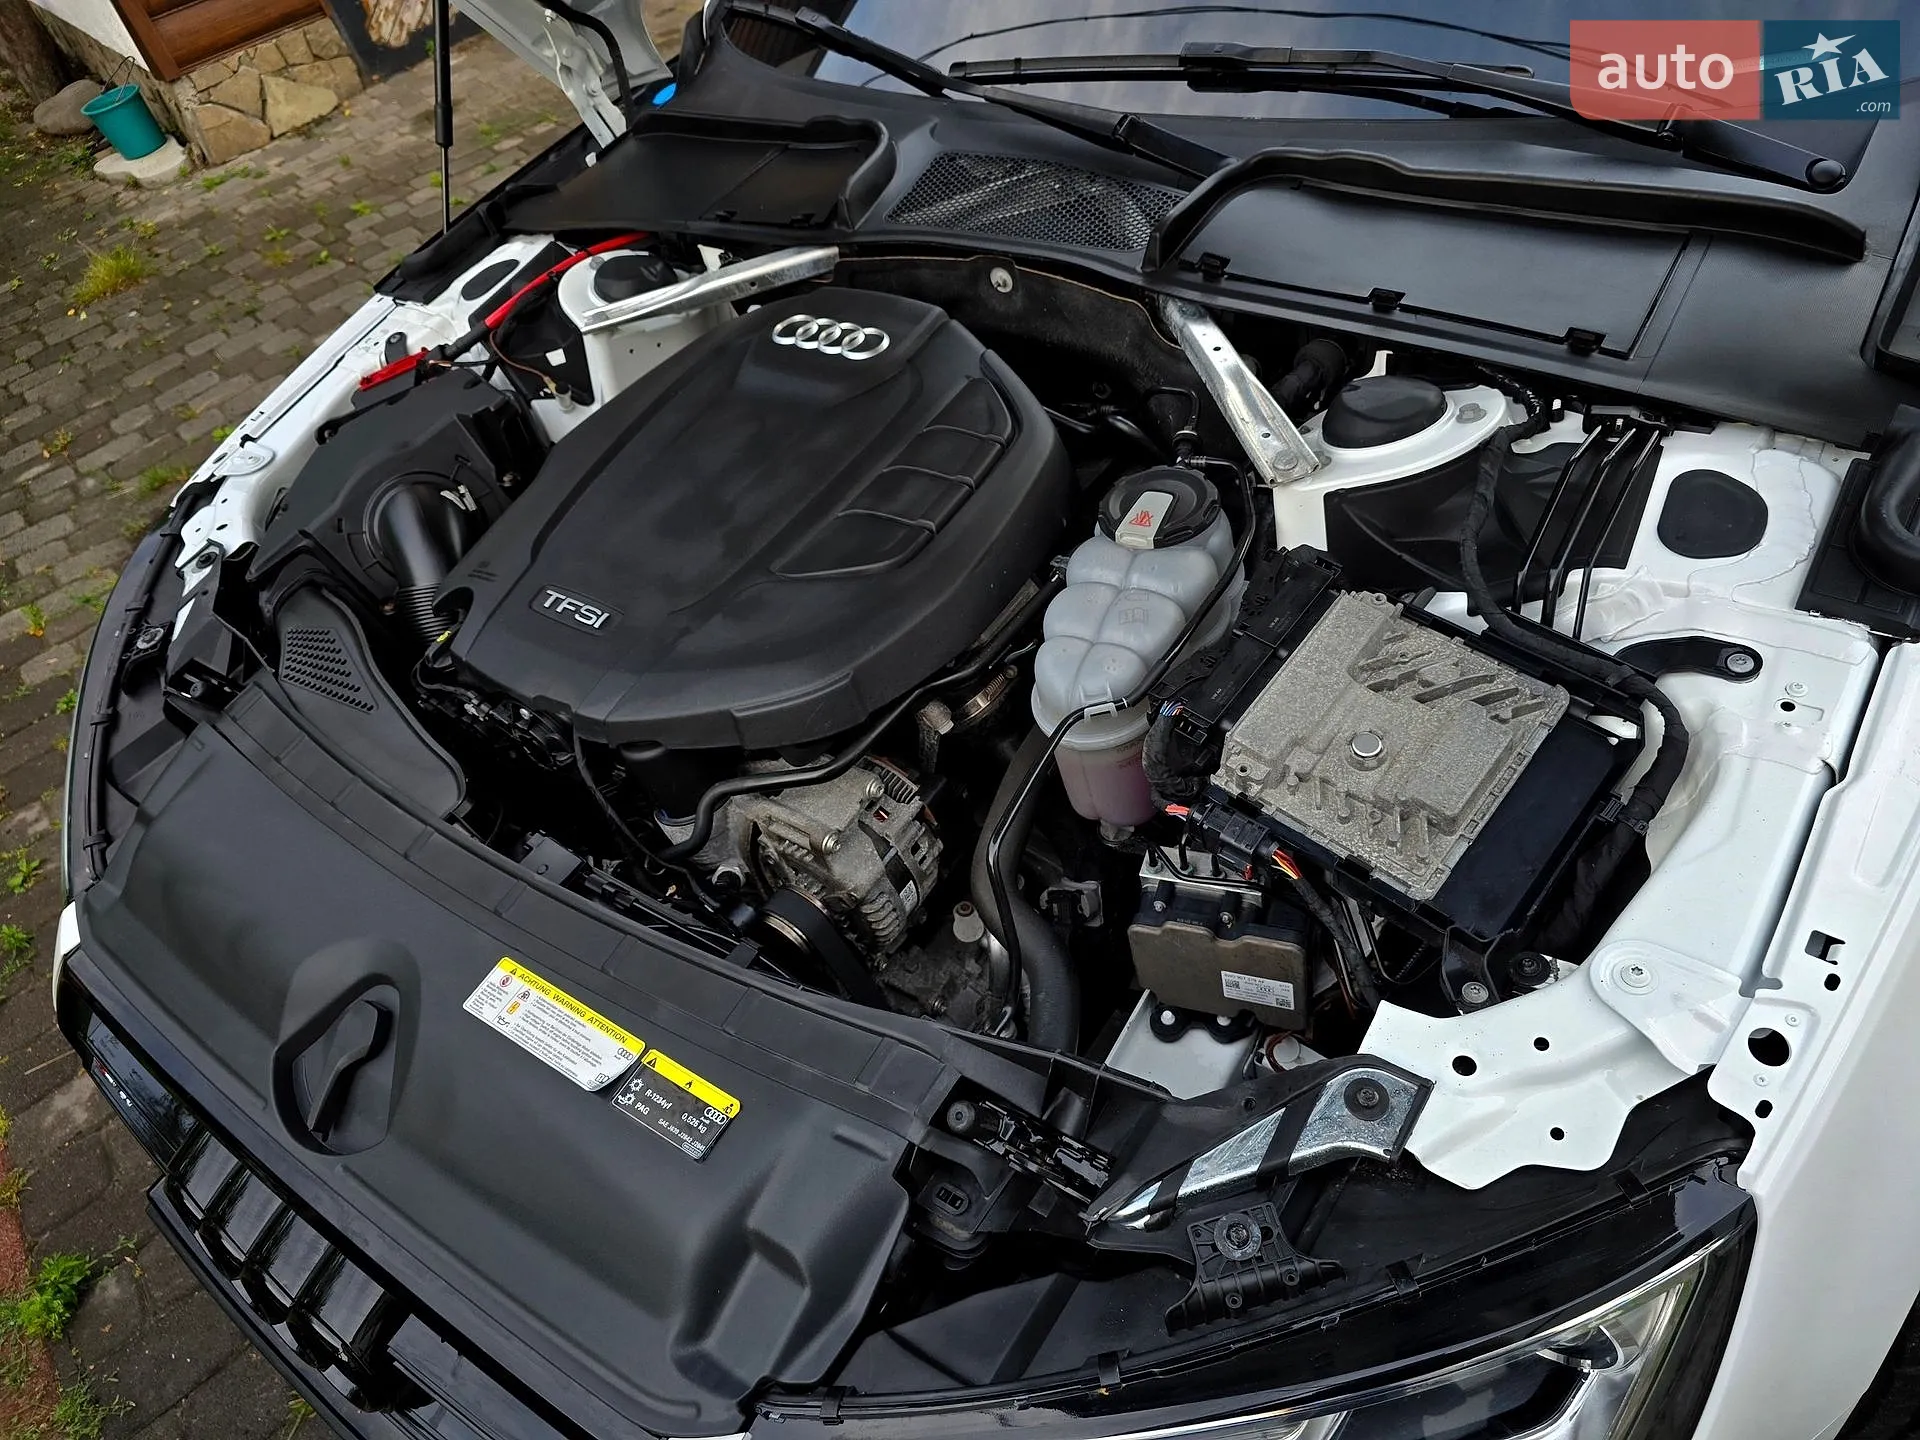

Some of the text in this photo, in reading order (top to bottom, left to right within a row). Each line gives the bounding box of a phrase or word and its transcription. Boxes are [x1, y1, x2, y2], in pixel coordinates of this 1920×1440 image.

[543, 589, 610, 629] TFSI
[519, 973, 551, 996] ACHTUNG
[552, 993, 586, 1018] WARNING
[587, 1016, 627, 1044] ATTENTION
[635, 1102, 650, 1116] PAG
[698, 1122, 708, 1134] kg
